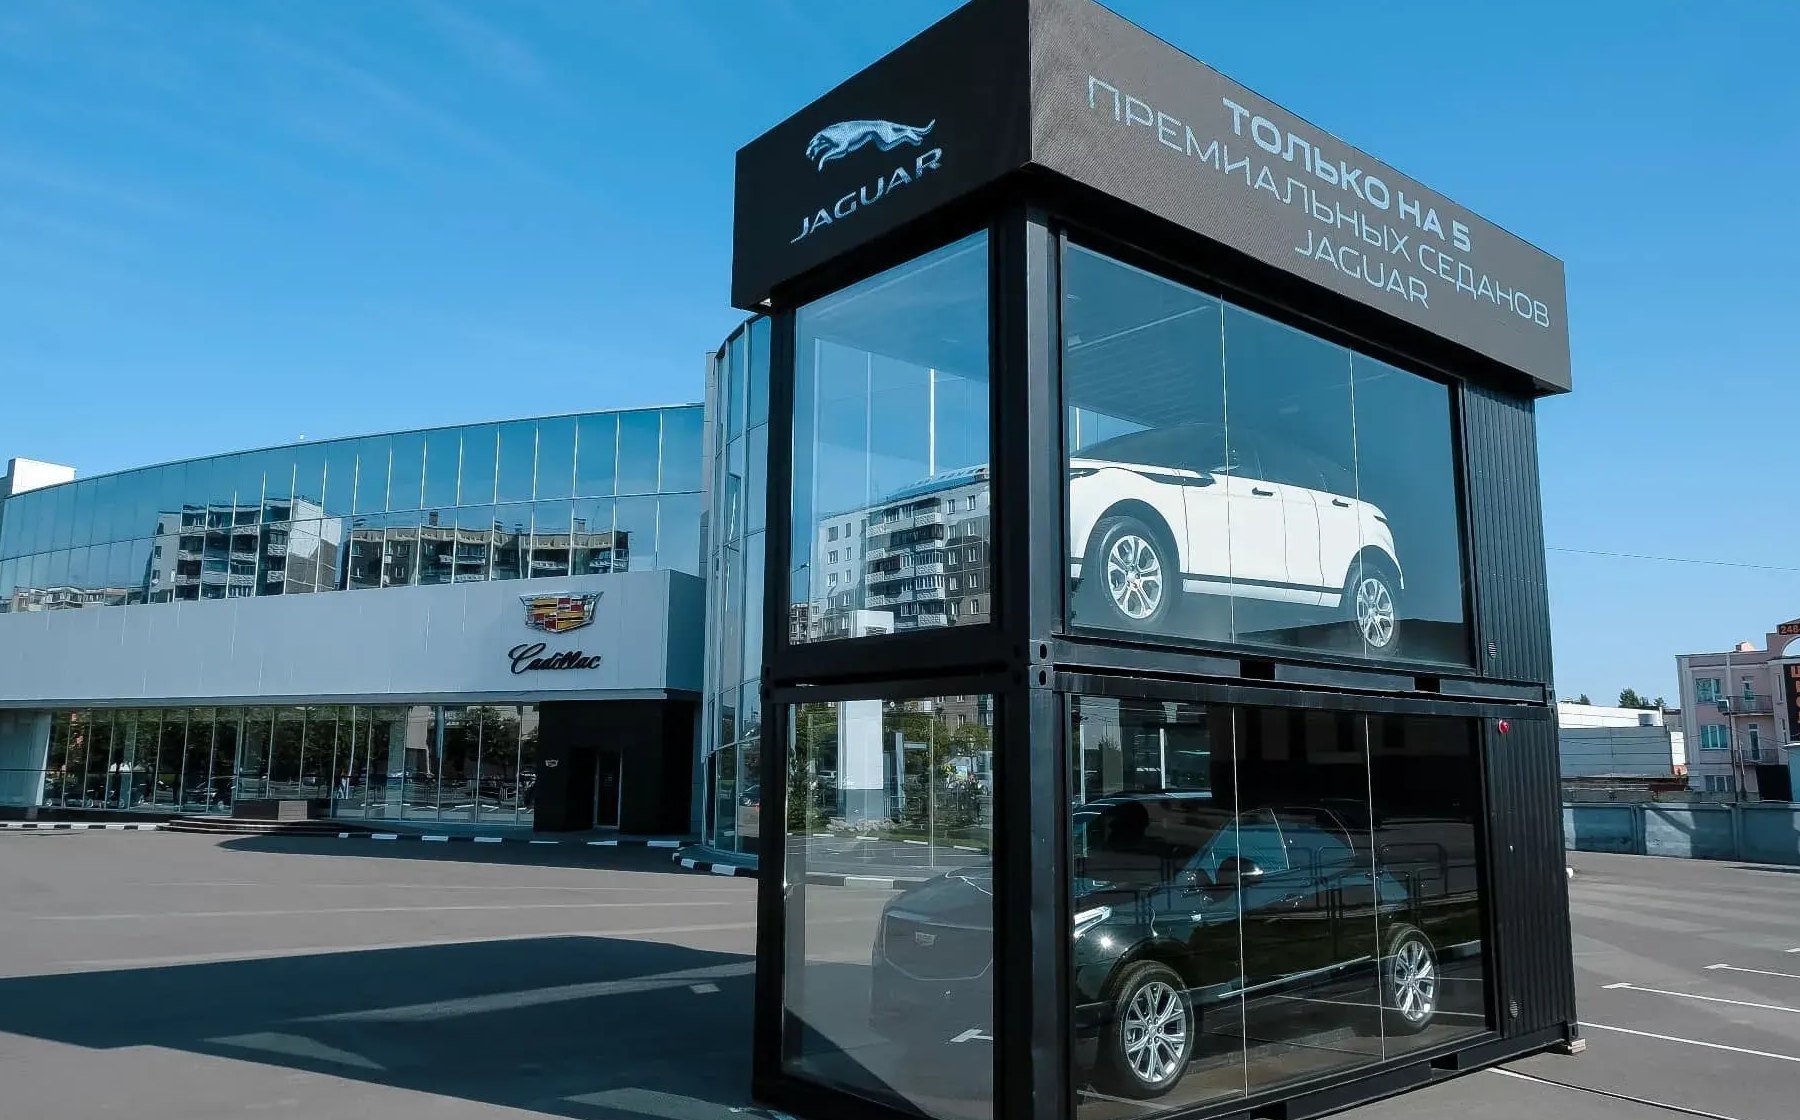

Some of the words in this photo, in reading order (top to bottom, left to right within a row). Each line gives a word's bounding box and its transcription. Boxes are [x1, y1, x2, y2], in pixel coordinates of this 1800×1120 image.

[790, 147, 943, 244] JAGUAR
[1088, 75, 1412, 262] ПРЕМИАЛЬНЫХ
[1418, 245, 1551, 328] СЕДАНОВ
[1222, 97, 1390, 211] ТОЛЬКО
[1399, 190, 1444, 240] НА
[1452, 219, 1472, 252] 5
[1295, 229, 1429, 309] JAGUAR
[507, 642, 602, 675] Cadillac
